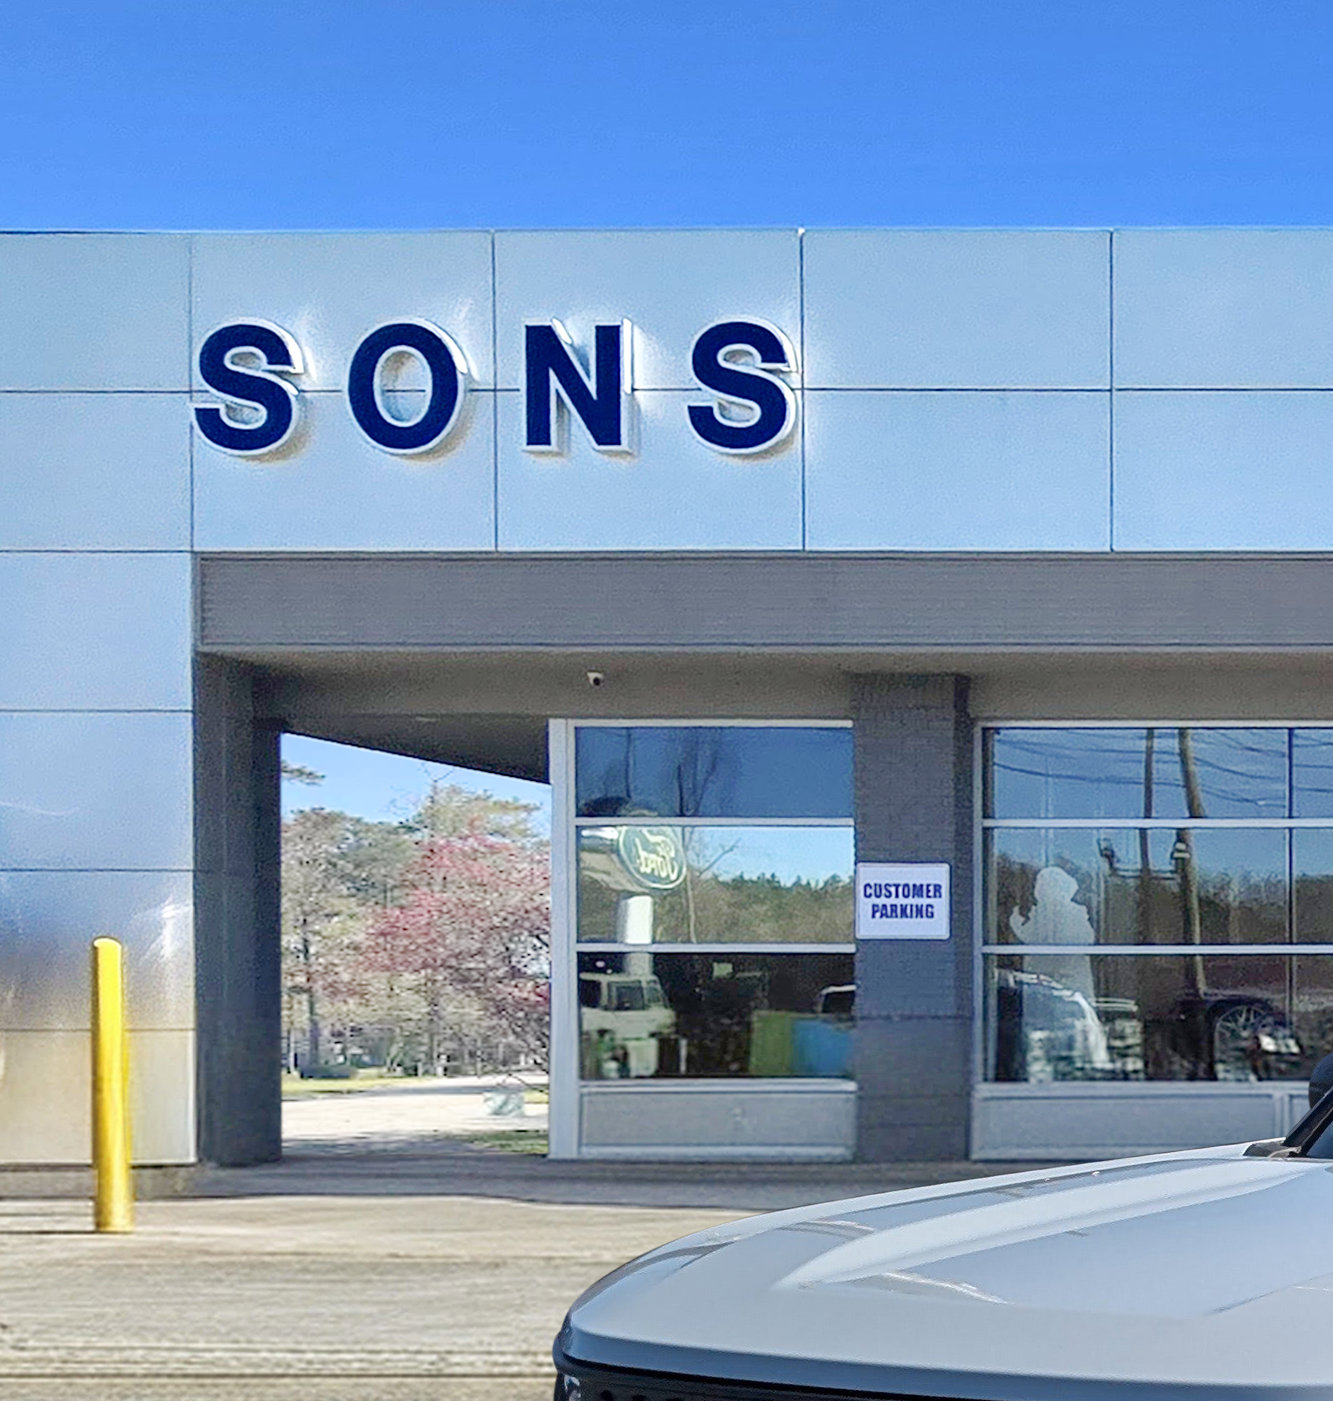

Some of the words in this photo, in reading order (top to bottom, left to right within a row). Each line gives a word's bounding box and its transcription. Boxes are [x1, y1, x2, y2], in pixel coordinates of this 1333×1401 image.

[193, 320, 792, 453] SONS
[863, 882, 942, 899] CUSTOMER
[871, 904, 934, 919] PARKING
